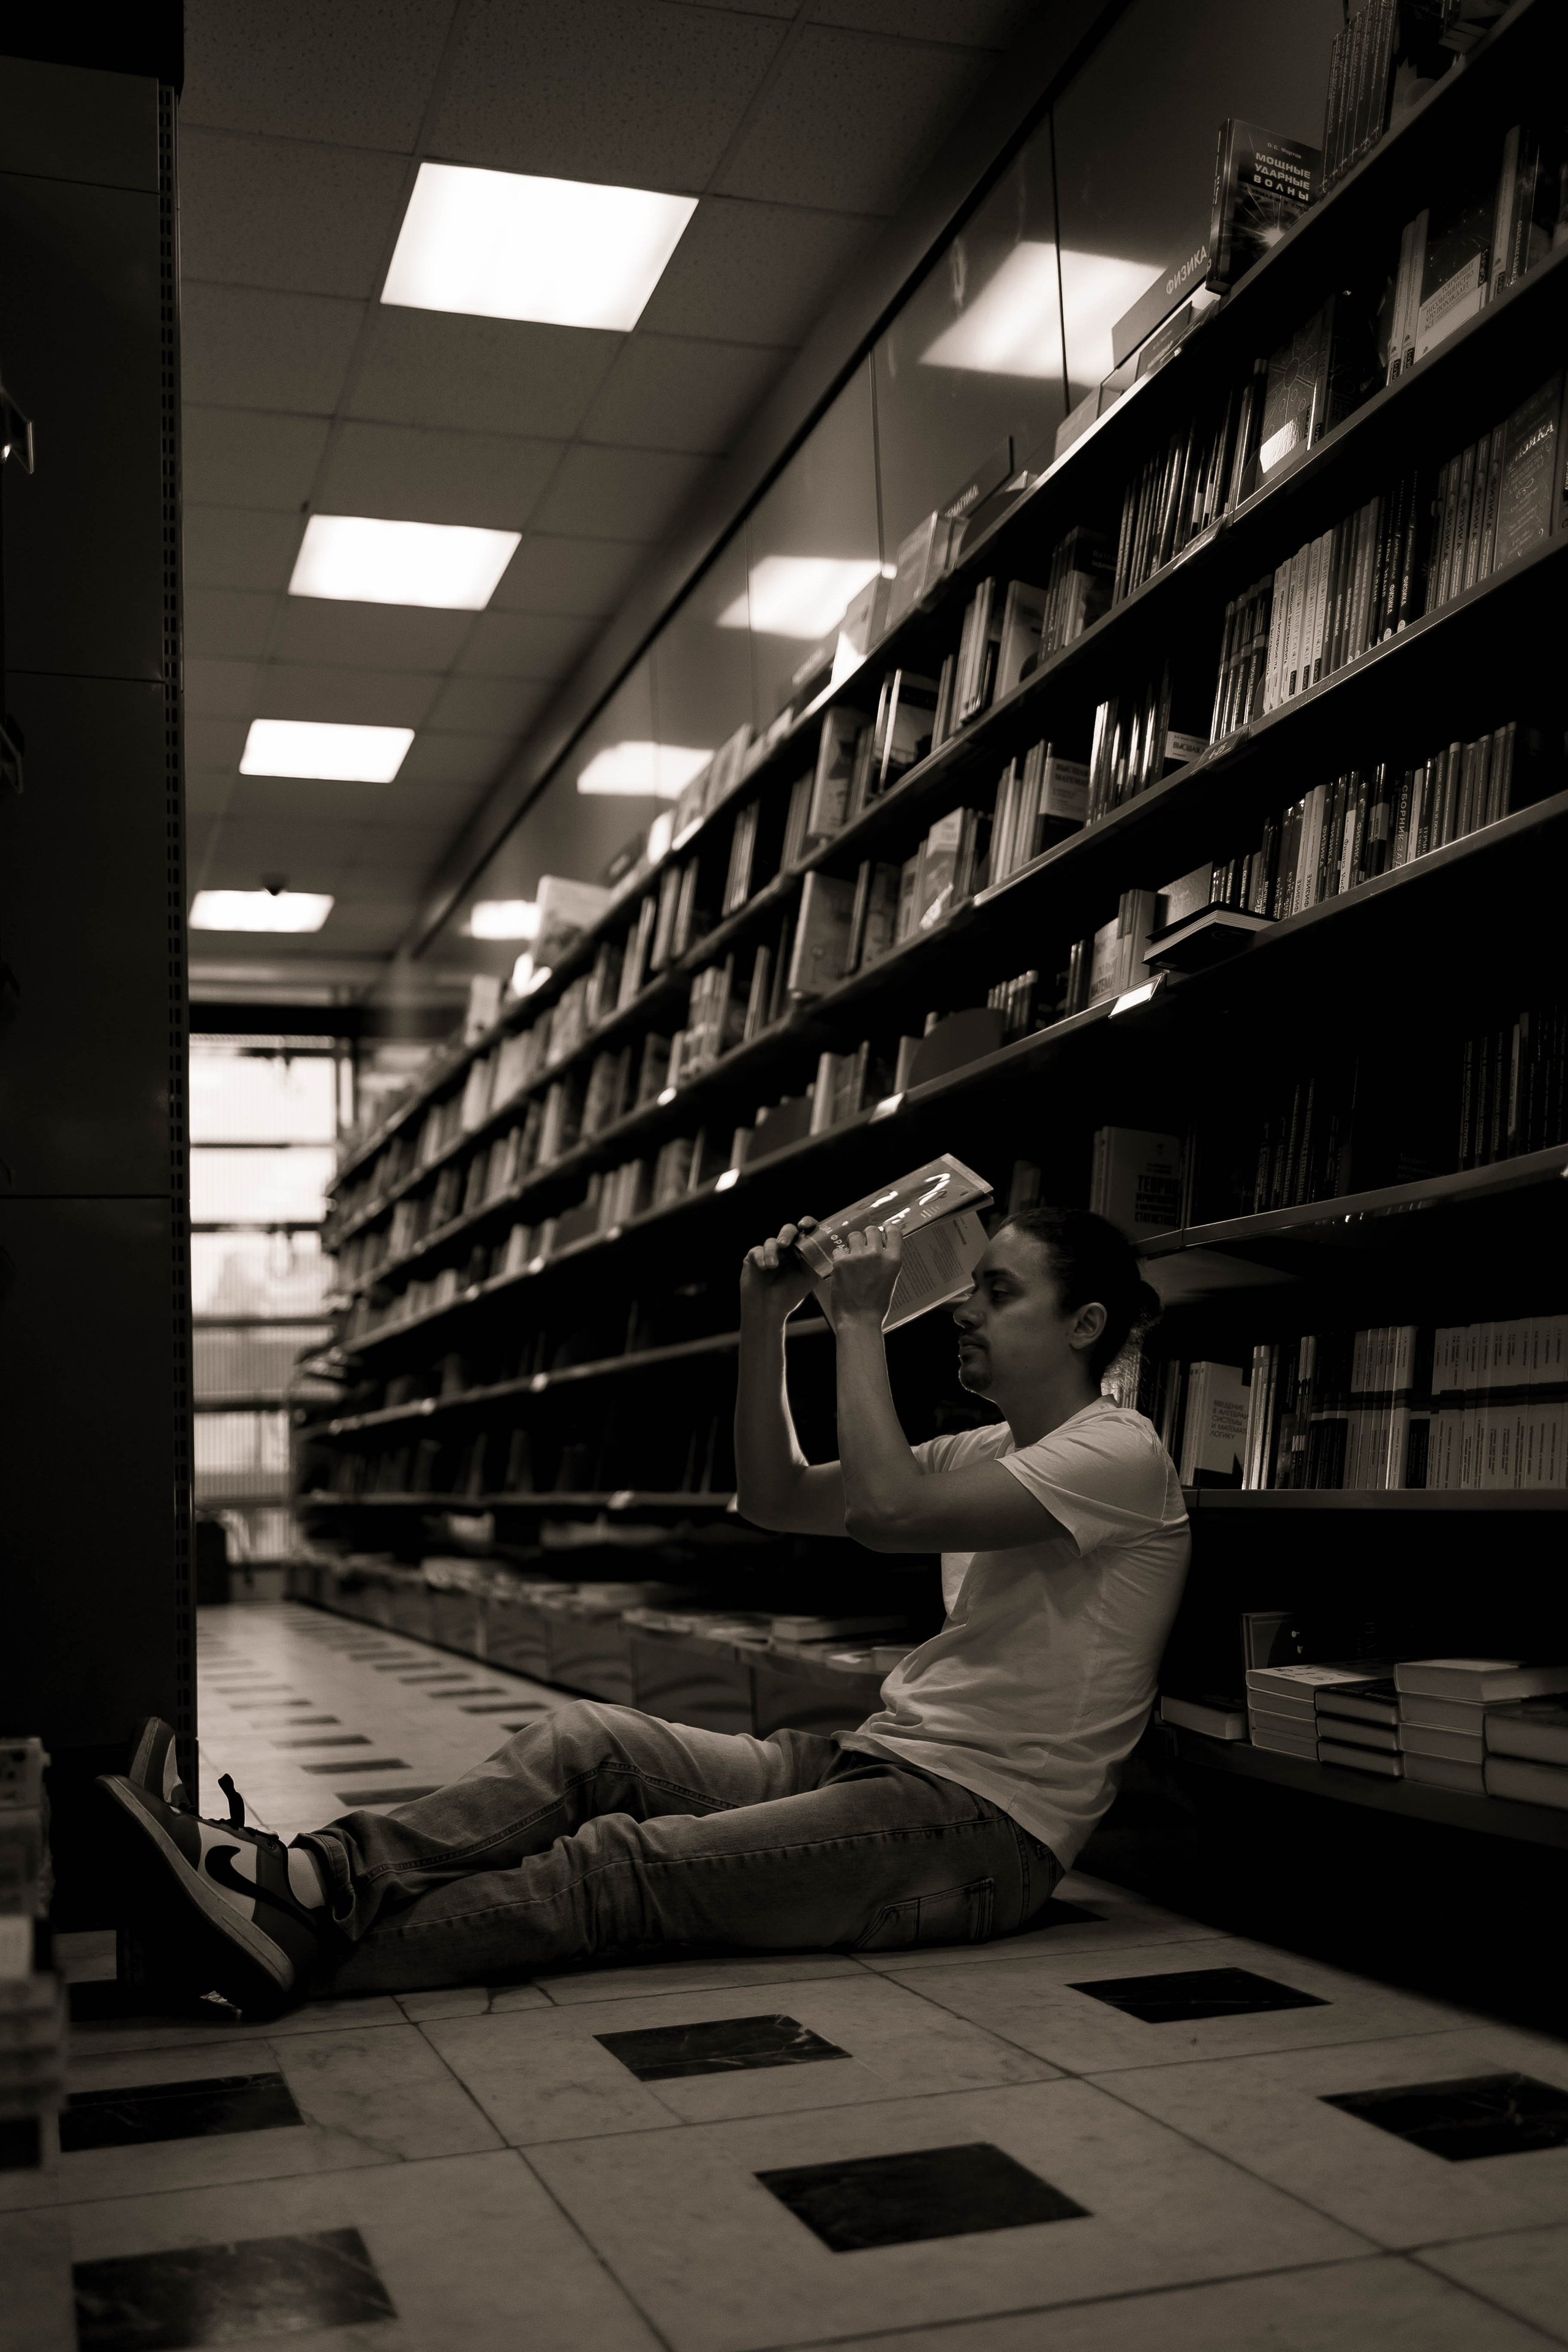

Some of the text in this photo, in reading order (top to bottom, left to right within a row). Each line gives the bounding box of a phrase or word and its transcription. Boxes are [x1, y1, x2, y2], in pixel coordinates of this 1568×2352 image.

[1255, 163, 1310, 190] УДАРНЫЕ
[1256, 153, 1311, 179] МОЩНЫЕ
[1254, 175, 1308, 202] ВОЛНЫ
[1166, 245, 1207, 295] ФИЗИКА
[1472, 488, 1482, 540] ФИЗИКА
[1486, 478, 1496, 530] ФИЗИКА
[1443, 508, 1453, 560] ФИЗИКА
[1457, 499, 1466, 550] ФИЗИКА
[1387, 584, 1395, 615] ФИЗИКА
[1400, 576, 1409, 606] ФИЗИКА
[1398, 785, 1408, 840] СБОРНИК
[1353, 822, 1362, 865] ФИЗИКА
[1212, 1415, 1242, 1425] СИСТЕМЫ
[1214, 1400, 1243, 1412] ВВЕДЕНИЕ
